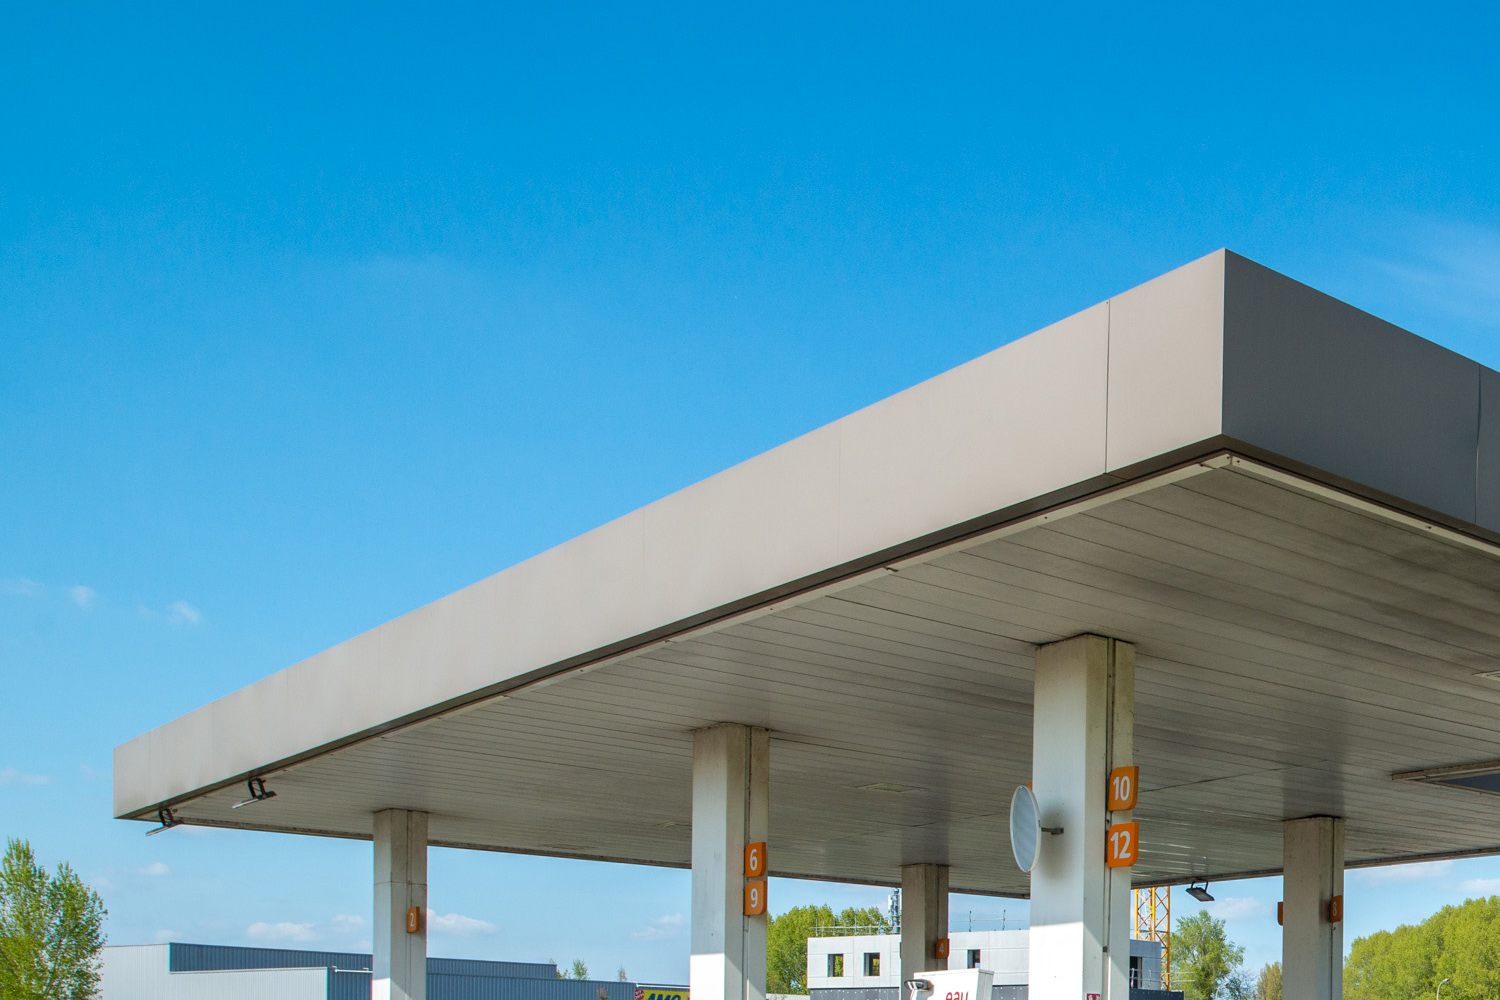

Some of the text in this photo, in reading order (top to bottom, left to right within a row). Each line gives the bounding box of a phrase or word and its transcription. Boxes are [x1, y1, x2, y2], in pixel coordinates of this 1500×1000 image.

[1113, 775, 1130, 801] 10
[1110, 830, 1131, 860] 12
[750, 848, 758, 871] 6
[750, 888, 758, 908] 9
[410, 912, 415, 927] 2
[938, 943, 945, 954] 4
